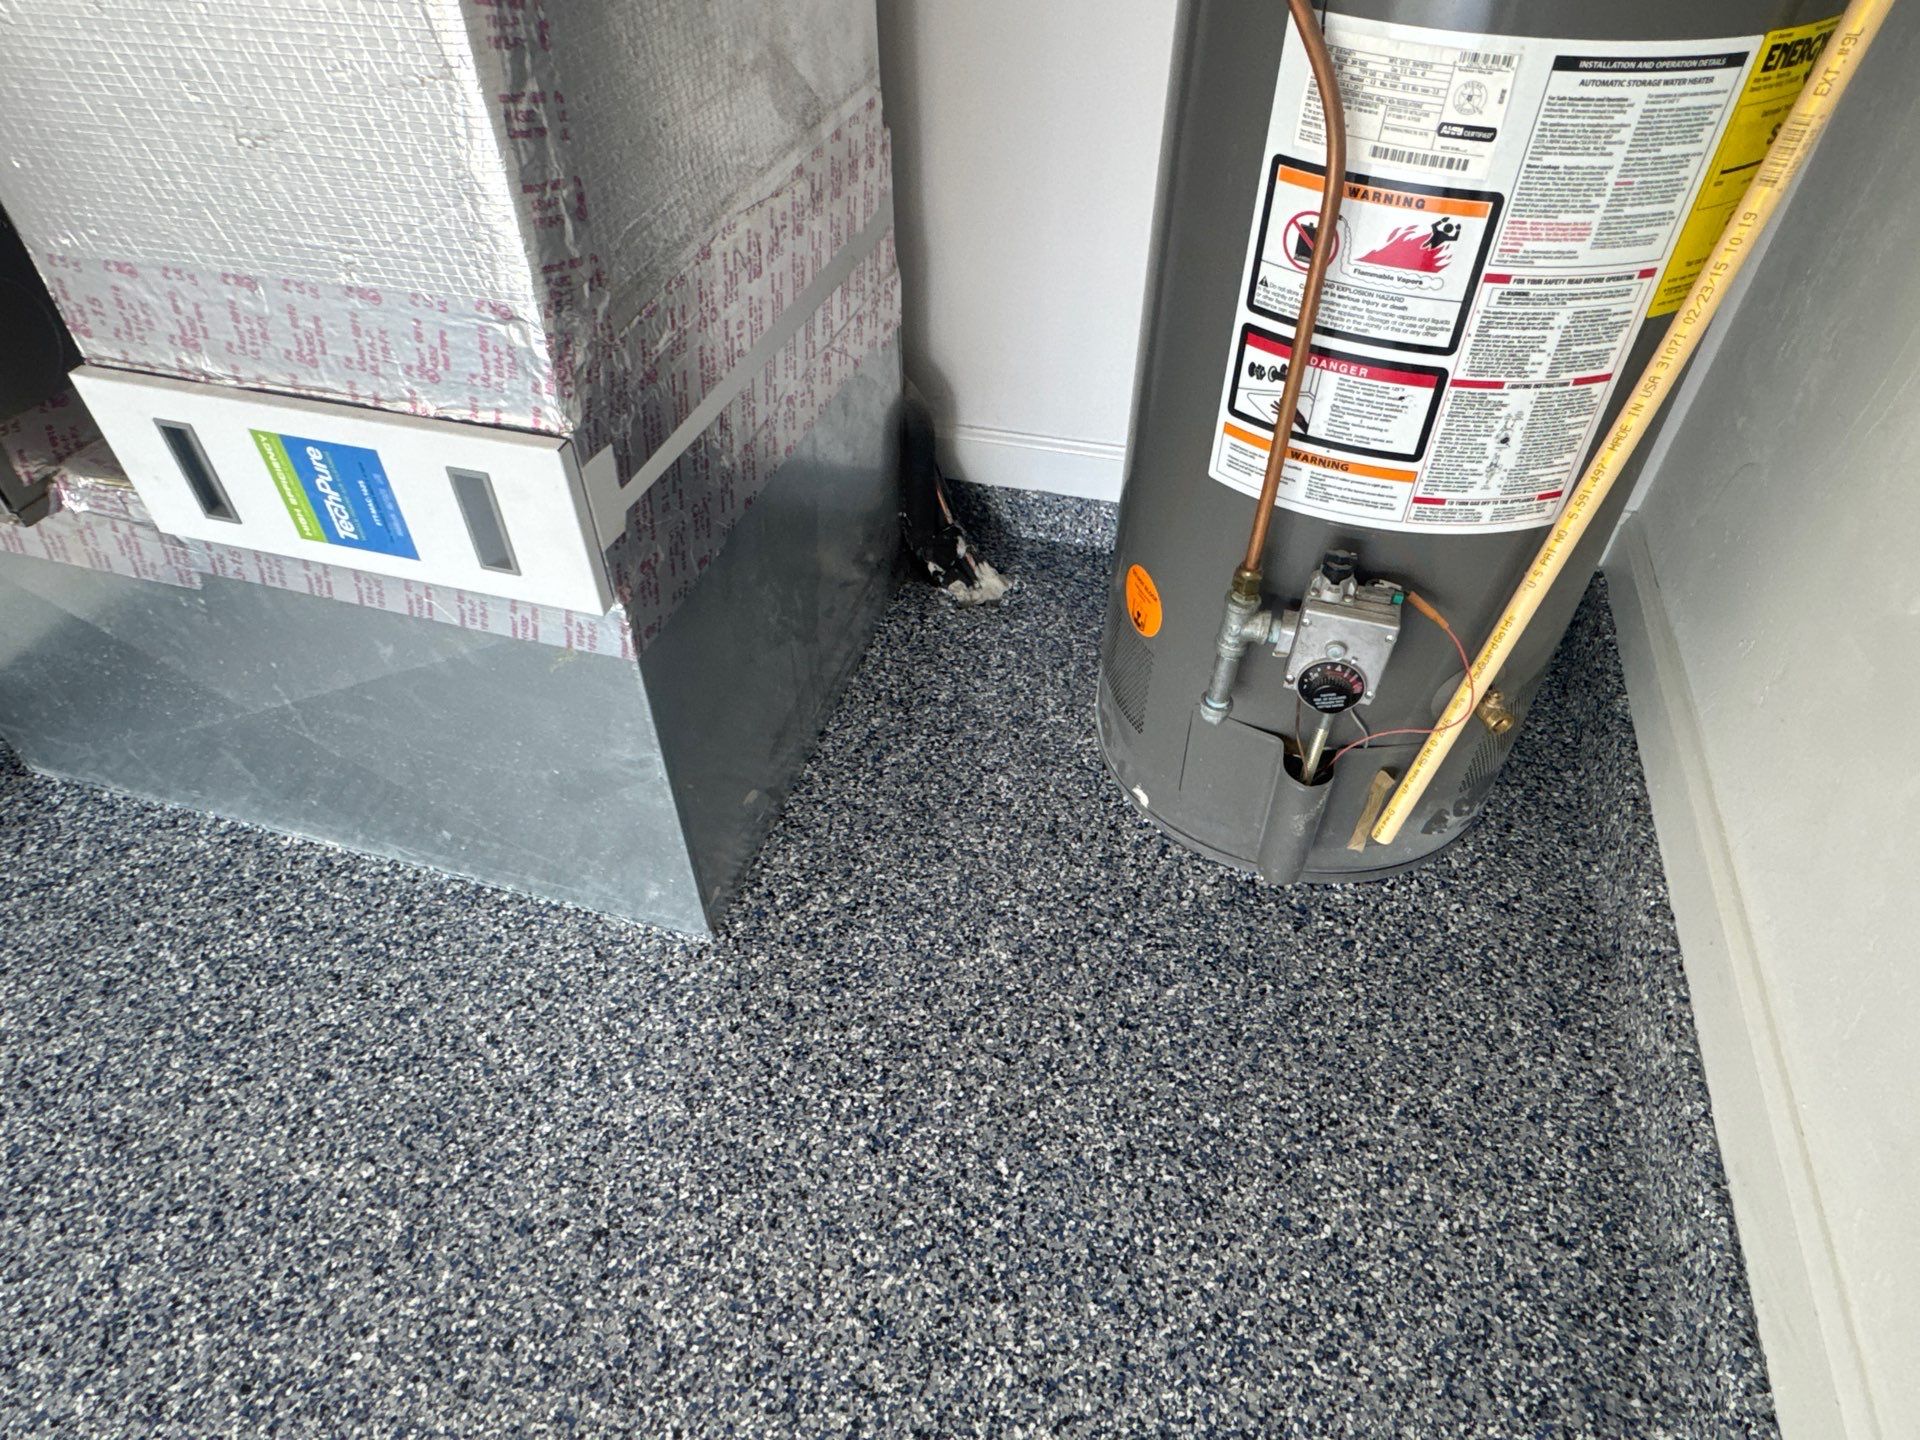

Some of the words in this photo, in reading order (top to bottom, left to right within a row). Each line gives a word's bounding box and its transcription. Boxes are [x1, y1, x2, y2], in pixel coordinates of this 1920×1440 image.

[1579, 57, 1635, 69] INSTALLATION
[1635, 58, 1654, 69] AND
[1655, 57, 1698, 69] OPERATION
[1698, 56, 1727, 67] DETAILS
[1579, 78, 1627, 87] AUTOMATIC
[1627, 77, 1662, 87] STORAGE
[1662, 77, 1688, 86] WATER
[1688, 75, 1715, 85] HEATER
[1349, 185, 1427, 211] WARNING
[1352, 267, 1395, 283] Flammable
[1397, 274, 1424, 288] Vapors
[1526, 278, 1543, 286] YOUR
[1544, 277, 1566, 286] SAFETY
[1567, 277, 1582, 285] READ
[1583, 275, 1605, 284] BEFORE
[1606, 274, 1635, 283] OPERATING
[1336, 284, 1375, 299] EXPLOSION
[1375, 293, 1405, 303] HAZARD
[1362, 298, 1380, 307] injury
[1389, 303, 1408, 311] death
[1309, 356, 1369, 378] DANGER
[258, 434, 298, 506] EFFICIENCY
[1290, 450, 1350, 472] WARNING
[305, 445, 360, 541] TechPure
[1417, 748, 1433, 767] ASTM
[1541, 548, 1557, 566] PAT
[1608, 424, 1632, 451] MADE
[1628, 402, 1644, 417] IN
[1643, 375, 1662, 399] USA
[1683, 261, 1729, 325] 02/23/15
[1724, 211, 1759, 254] 10:19
[294, 507, 313, 538] HIGH
